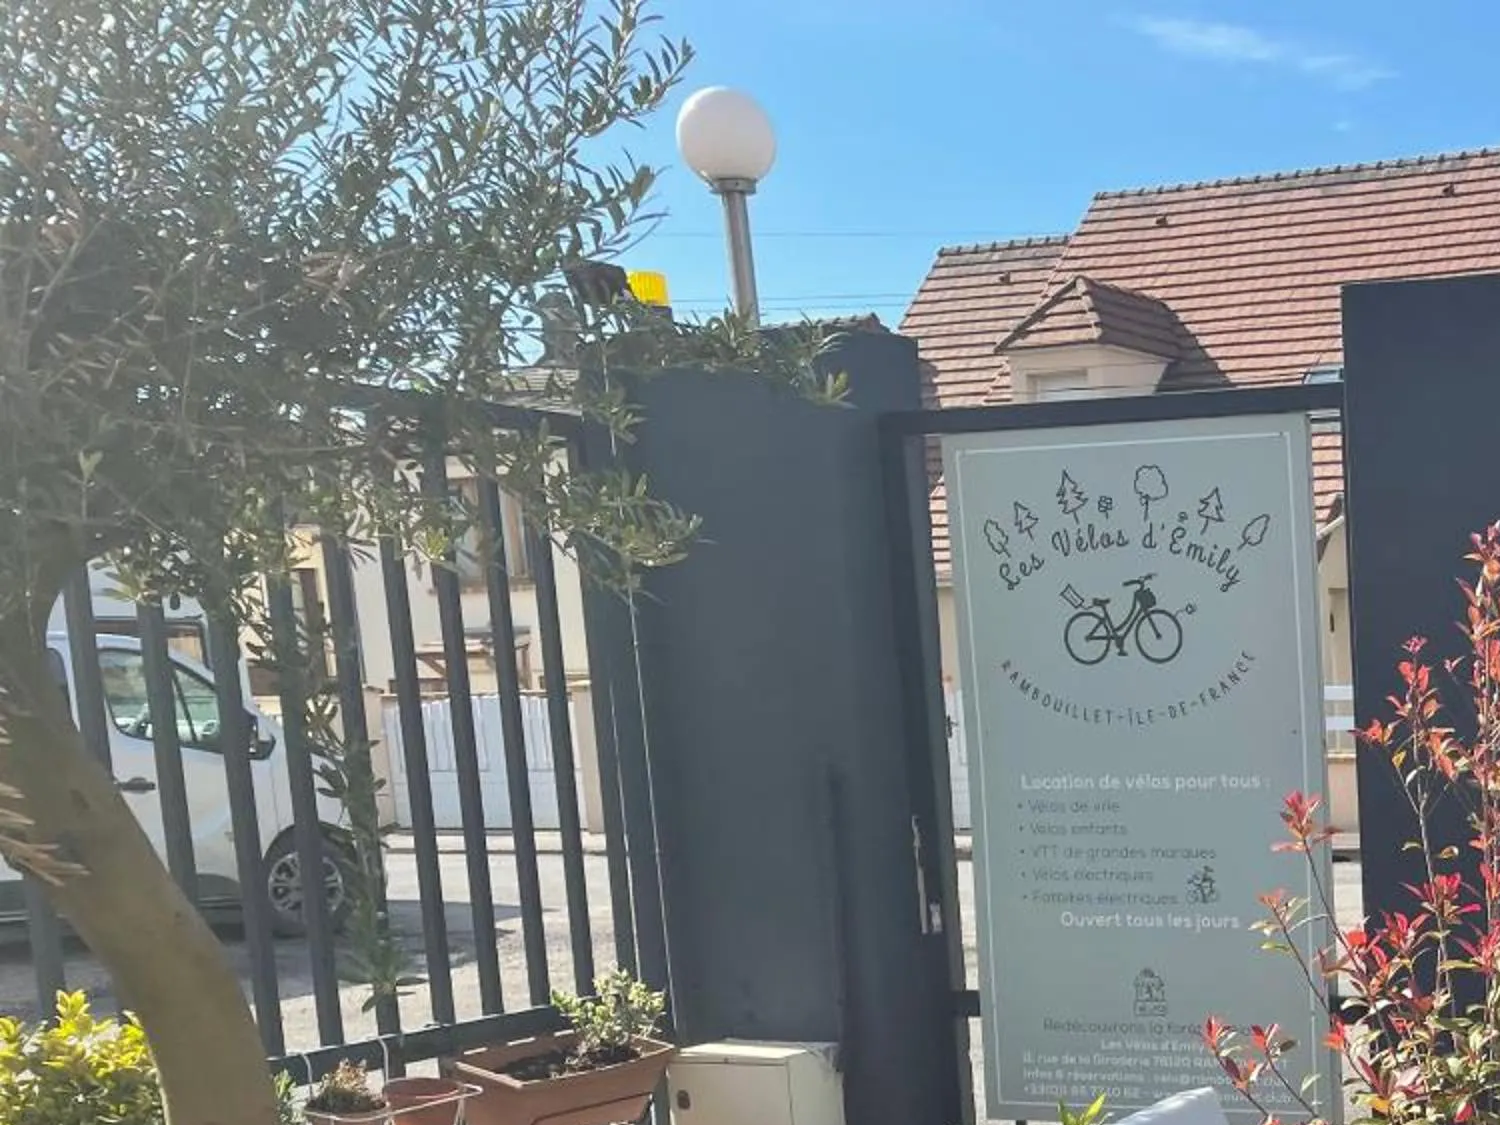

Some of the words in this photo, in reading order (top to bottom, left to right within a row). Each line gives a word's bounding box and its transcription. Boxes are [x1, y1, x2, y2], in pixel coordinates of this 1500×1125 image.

[1000, 554, 1045, 591] Les
[1051, 524, 1129, 557] Vélos
[1020, 774, 1095, 791] Location
[1098, 775, 1120, 790] de
[1126, 774, 1170, 790] vélos
[1175, 776, 1216, 793] pour
[1219, 774, 1261, 789] tous
[1060, 911, 1121, 928] Ouvert
[1125, 912, 1164, 928] tous
[1166, 913, 1192, 928] les
[1194, 913, 1241, 933] jours
